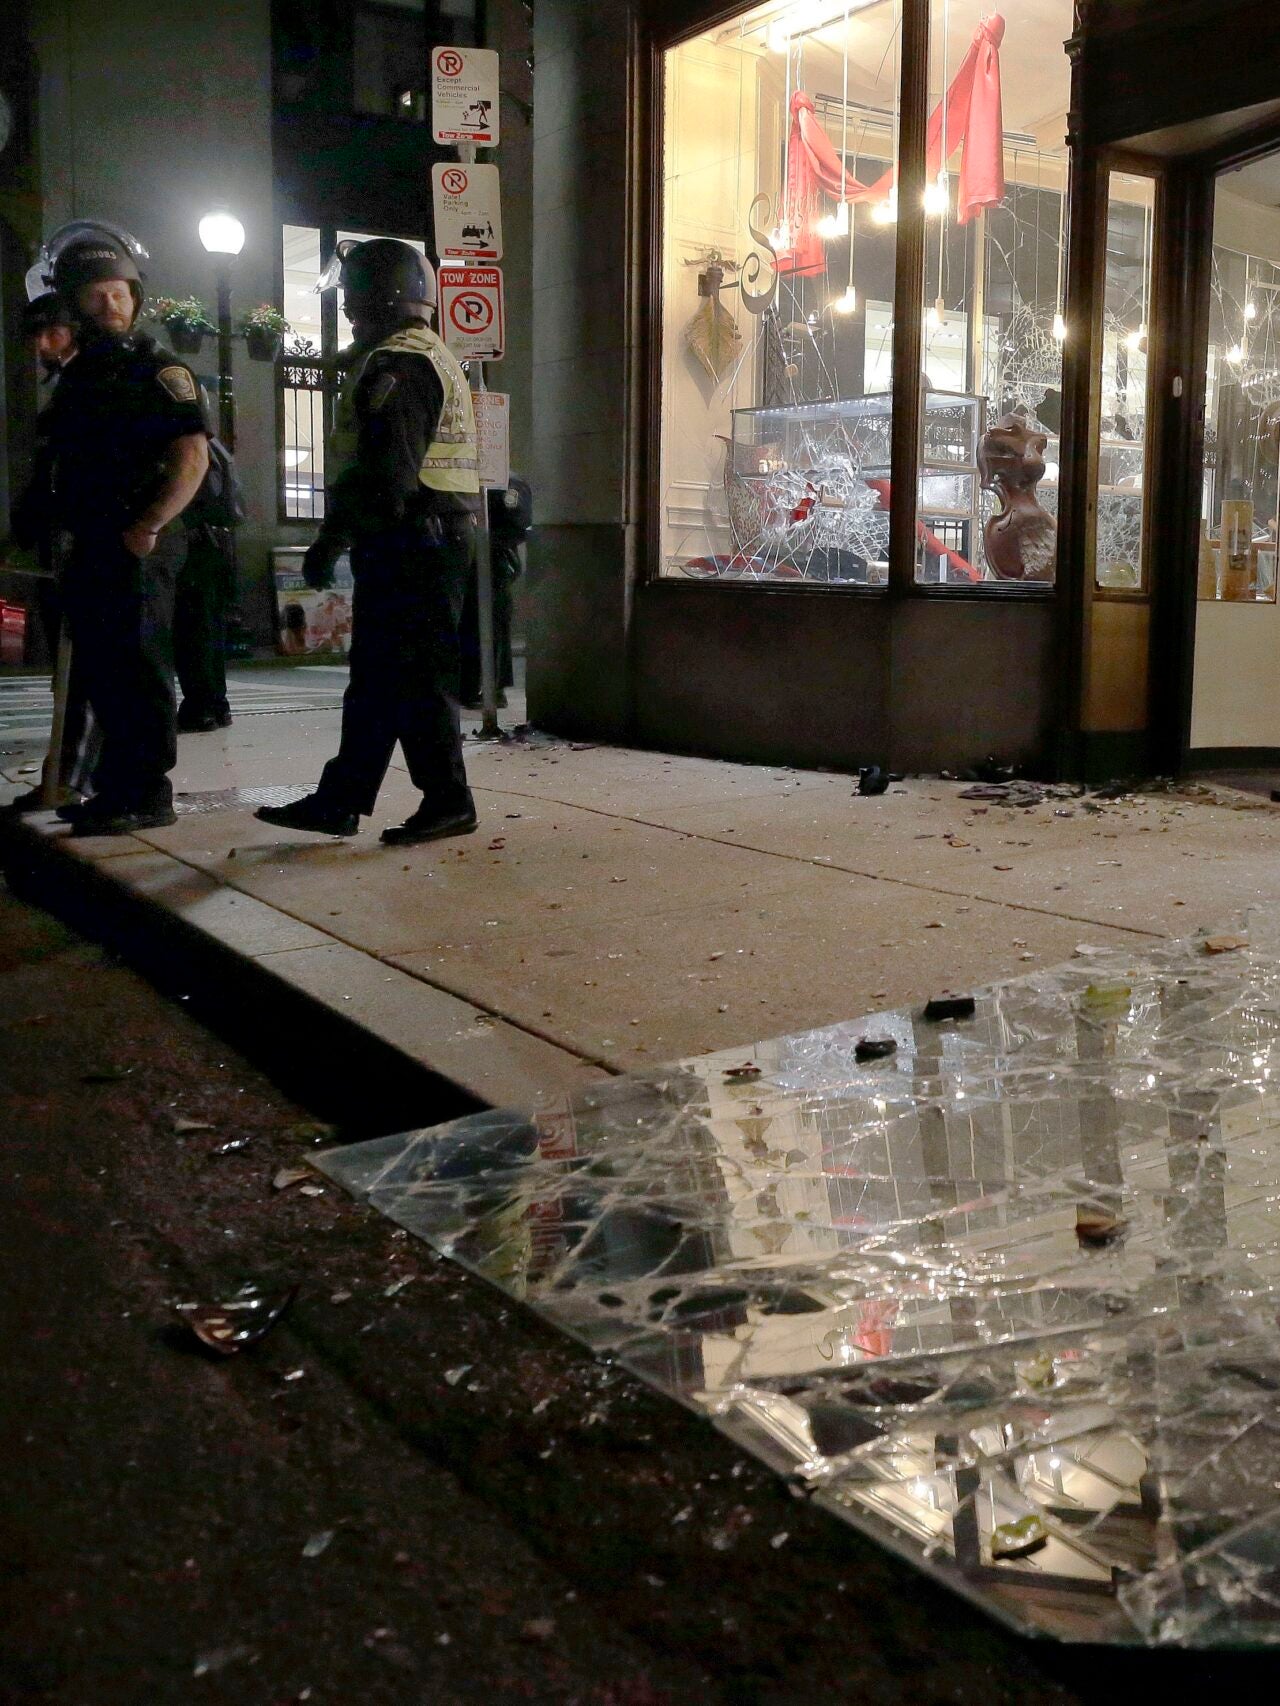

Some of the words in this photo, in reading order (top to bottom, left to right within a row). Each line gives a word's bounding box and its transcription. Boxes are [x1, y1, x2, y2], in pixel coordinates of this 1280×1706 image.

[437, 76, 462, 84] Except
[443, 199, 469, 207] Parking
[442, 273, 465, 284] TOW
[470, 272, 497, 284] ZONE
